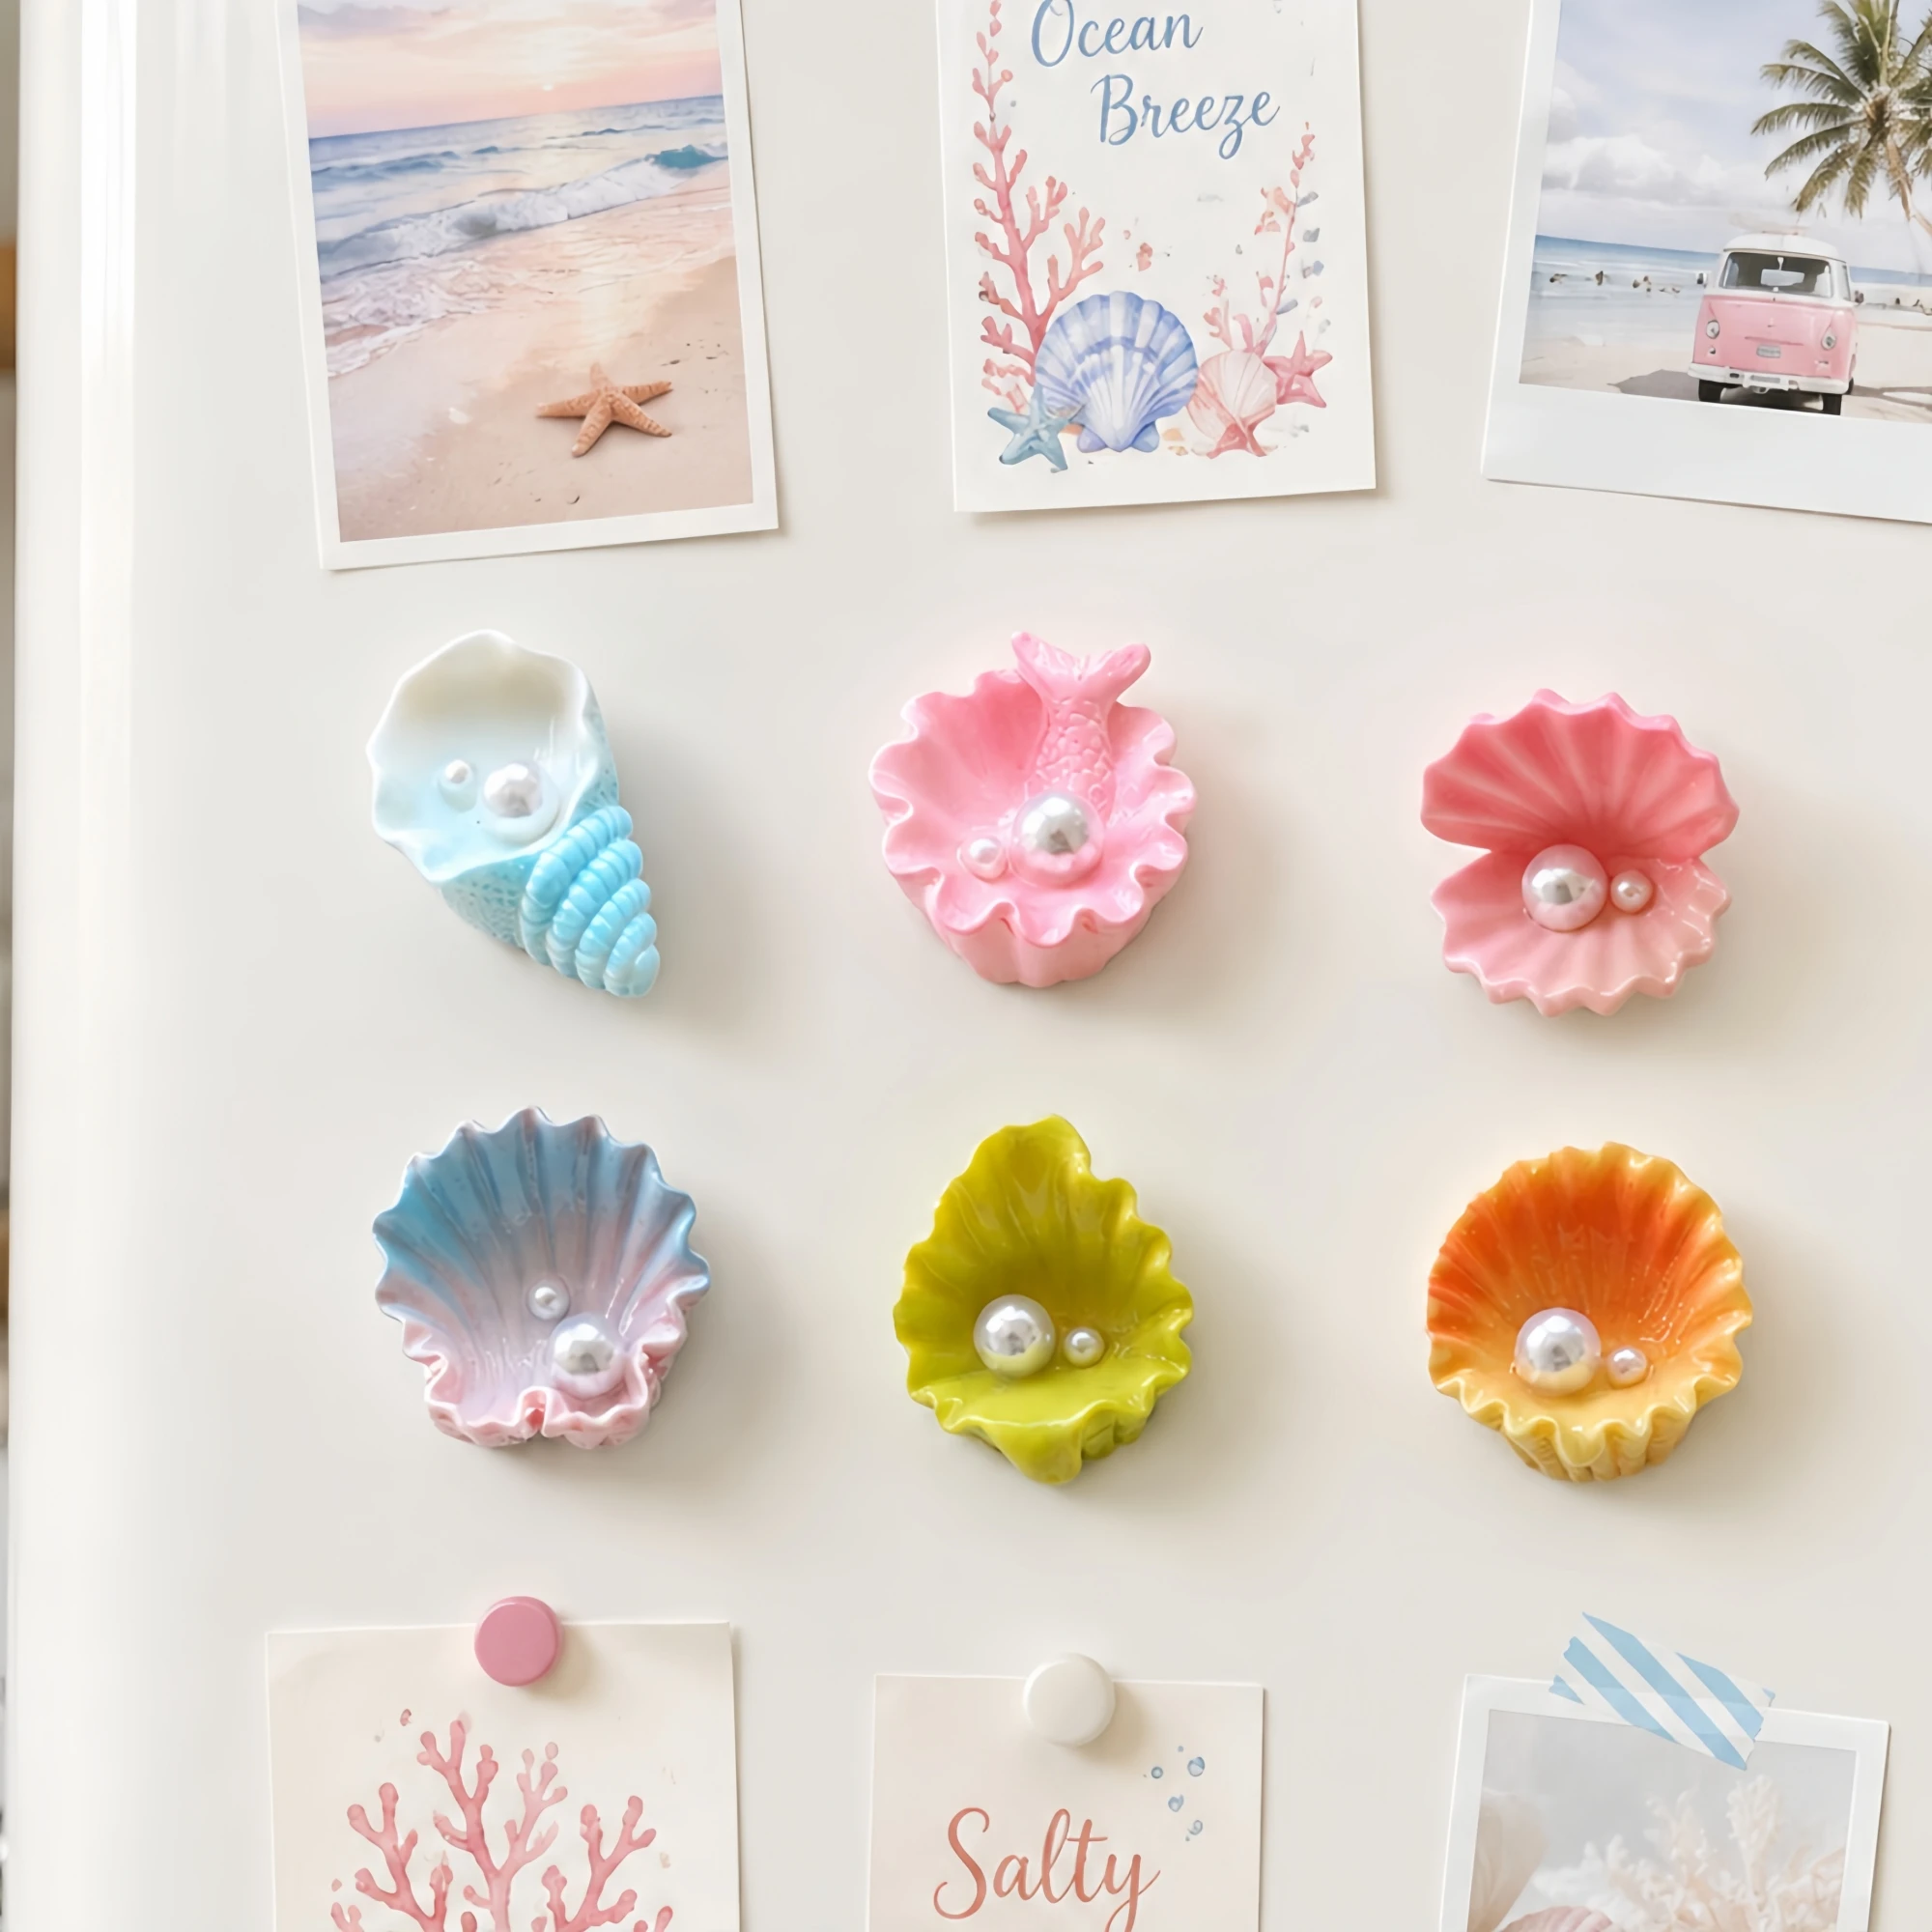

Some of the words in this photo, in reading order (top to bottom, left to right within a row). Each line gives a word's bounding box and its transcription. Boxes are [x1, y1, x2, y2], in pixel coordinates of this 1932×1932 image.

[1031, 0, 1204, 68] Ocean
[1090, 73, 1281, 159] Breeze
[933, 1806, 1161, 1932] Salty
